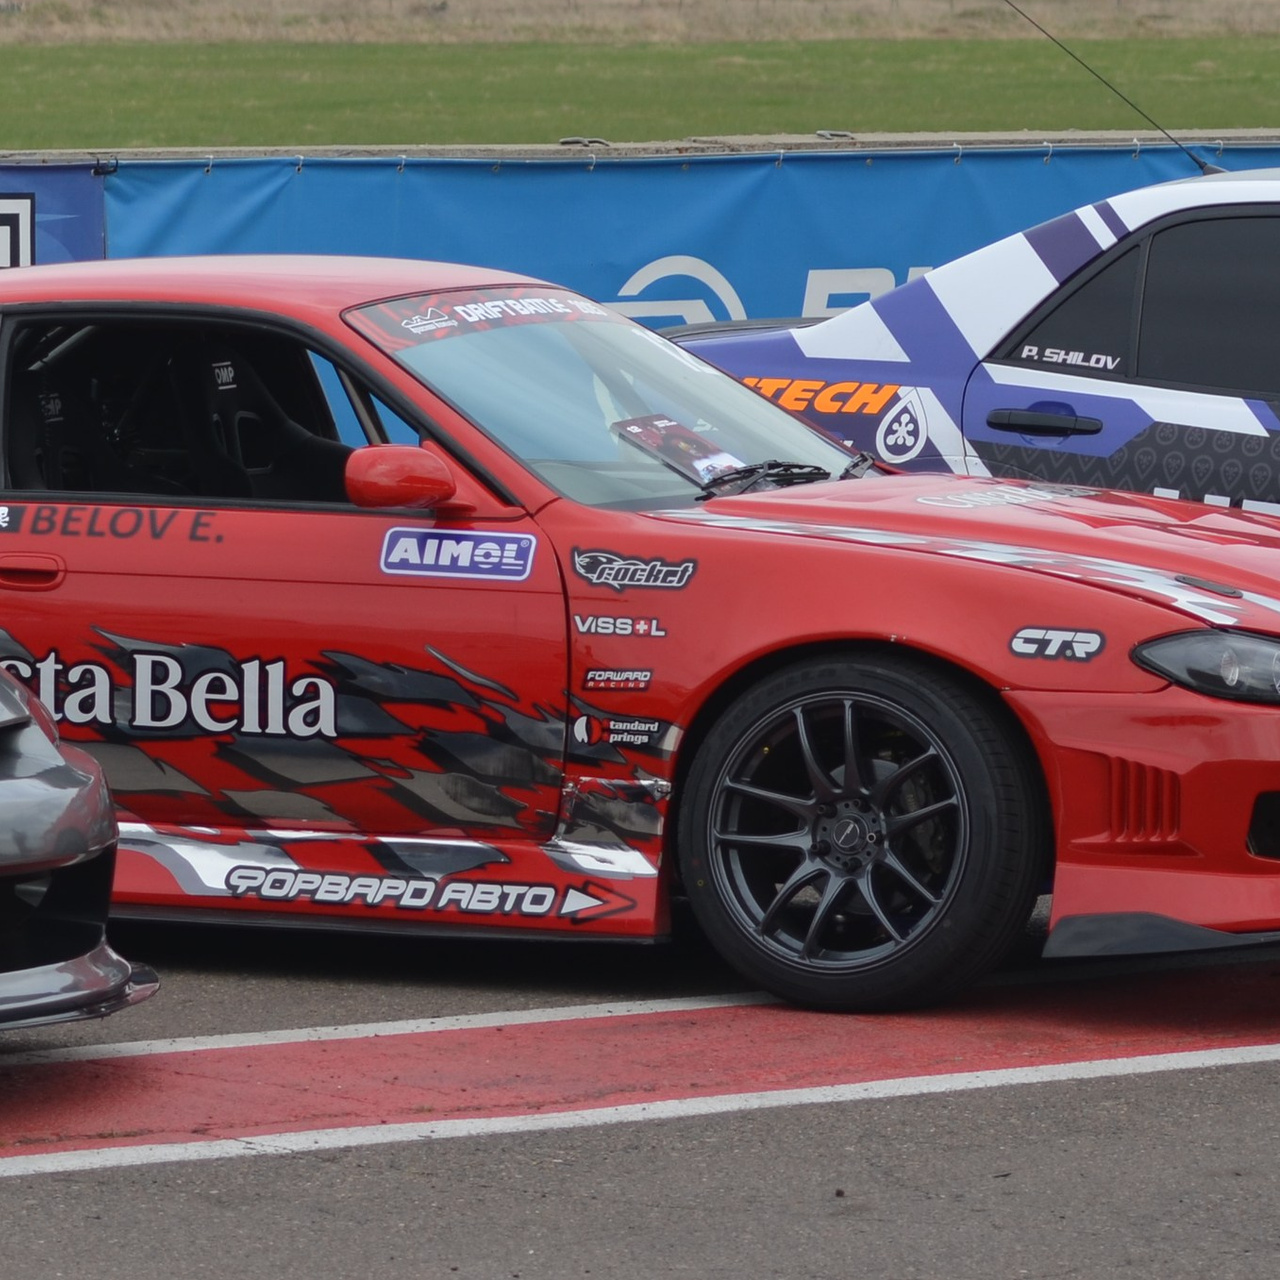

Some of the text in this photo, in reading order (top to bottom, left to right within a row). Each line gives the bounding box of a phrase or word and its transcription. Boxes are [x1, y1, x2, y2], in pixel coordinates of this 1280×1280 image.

[453, 304, 515, 322] DRIFT
[508, 297, 572, 316] BATTLE
[1021, 345, 1121, 370] P. SHILOV
[29, 505, 224, 543] BELOV E.
[387, 537, 524, 570] AIMOL
[587, 671, 651, 681] FORWARD
[132, 653, 337, 738] Bella
